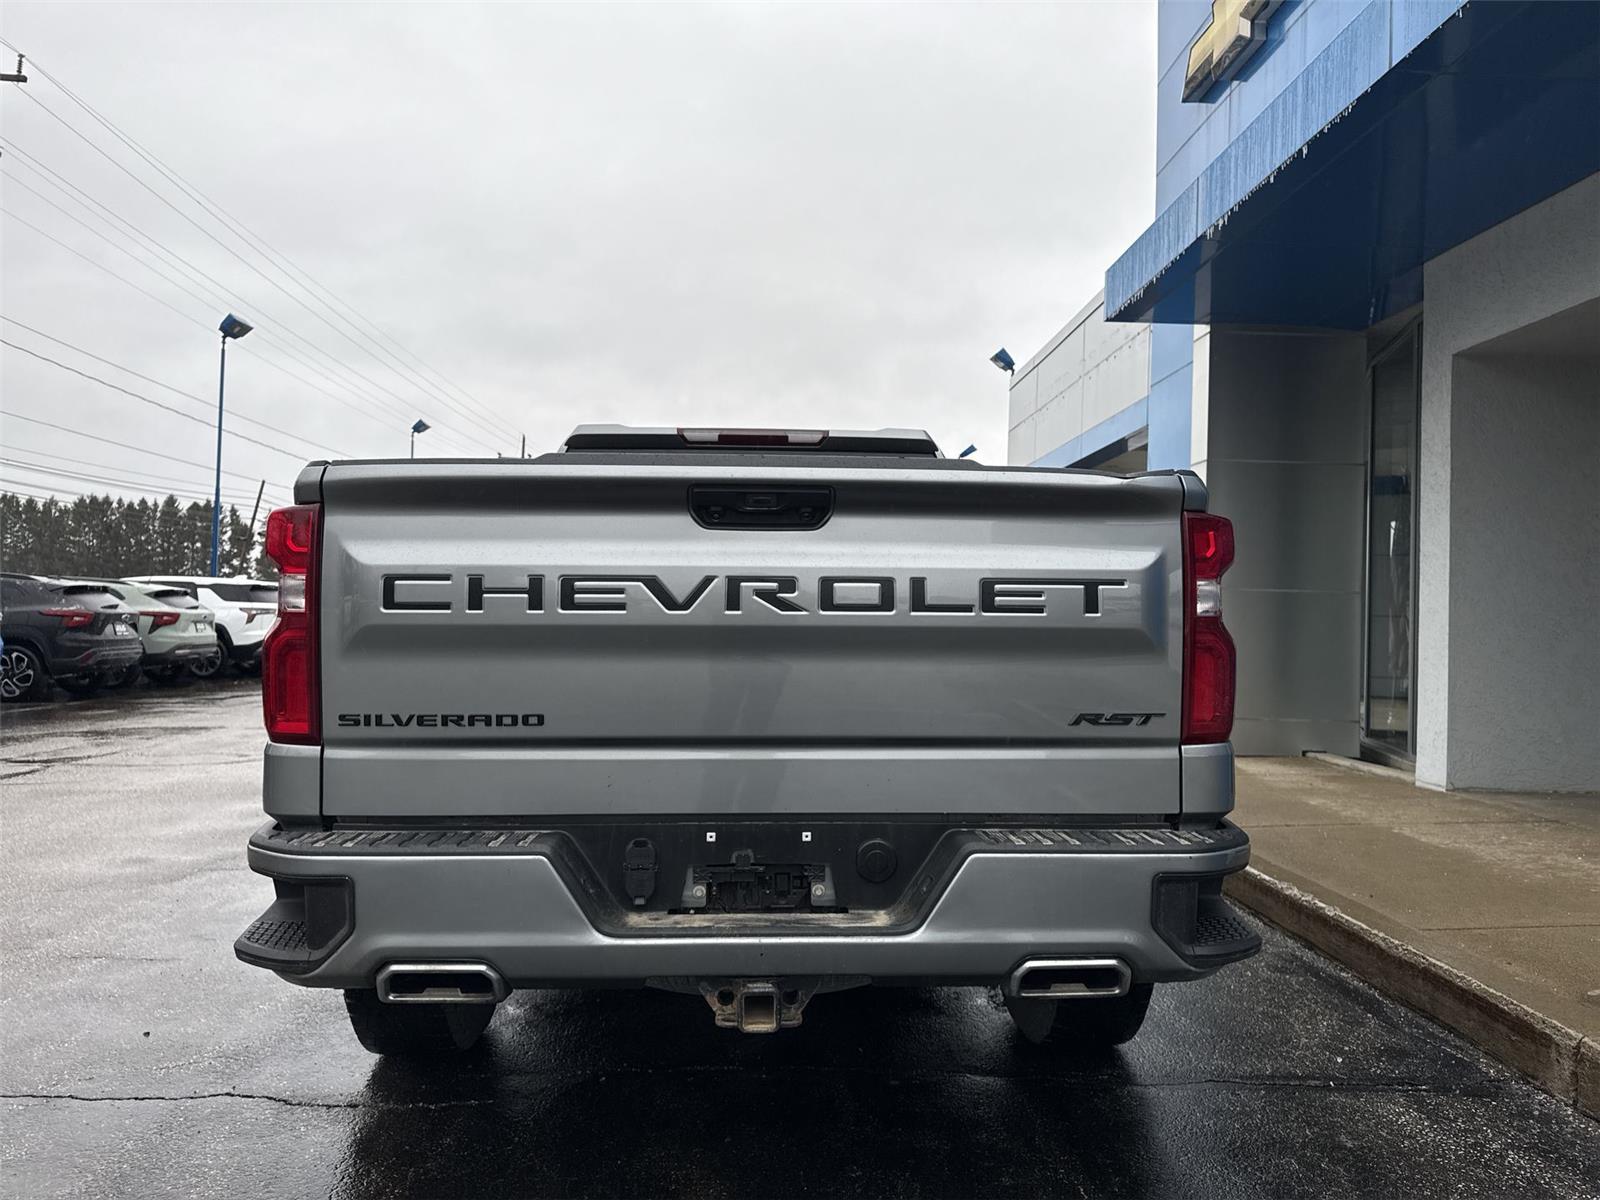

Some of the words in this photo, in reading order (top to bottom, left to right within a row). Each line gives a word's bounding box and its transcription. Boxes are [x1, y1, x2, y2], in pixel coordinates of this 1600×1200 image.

[380, 573, 1129, 617] CHEVROLET
[337, 713, 546, 728] SILVERADO
[1068, 712, 1167, 727] RST
